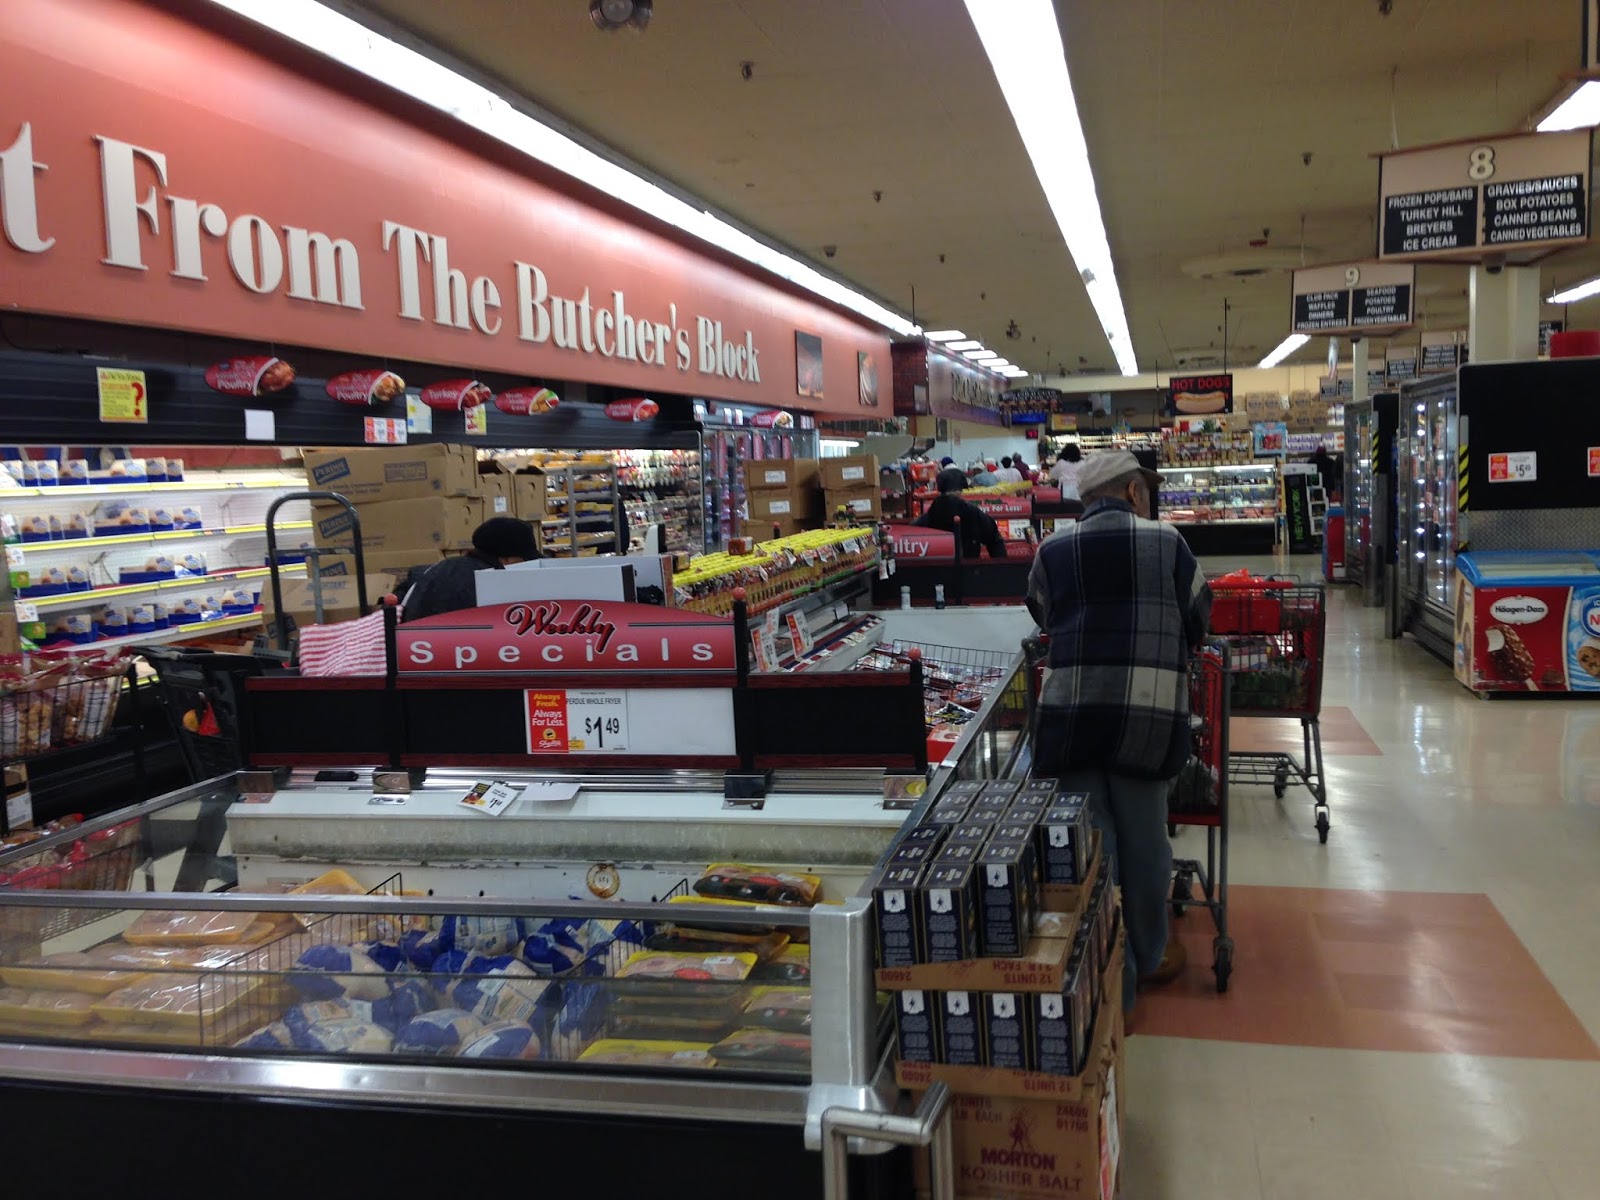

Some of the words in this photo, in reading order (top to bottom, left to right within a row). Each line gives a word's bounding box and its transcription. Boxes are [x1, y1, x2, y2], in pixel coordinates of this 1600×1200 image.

[1468, 146, 1495, 181] 8
[1487, 175, 1578, 198] GRAVIES/SAUCES
[1388, 194, 1422, 209] FROZEN
[1424, 188, 1474, 205] POPS/BARS
[1496, 198, 1517, 212] BOX
[1520, 191, 1574, 209] POTATOES
[1400, 207, 1440, 222] TURKEY
[1441, 204, 1464, 217] HILL
[1494, 211, 1538, 227] CANNED
[1540, 207, 1577, 223] BEANS
[1406, 220, 1453, 236] BREYERS
[1490, 228, 1525, 243] CANNED
[1526, 222, 1581, 239] VEGETABLES
[1403, 237, 1419, 251] ICE
[1421, 235, 1457, 250] CREAM
[92, 134, 365, 310] From
[382, 220, 502, 336] The
[514, 260, 692, 370] Butcher's
[696, 315, 761, 383] Block
[1345, 266, 1360, 288] 9
[1366, 287, 1397, 297] SEAFOOD
[1308, 301, 1335, 311] WAFFLES
[1365, 295, 1396, 306] POTATOES
[1367, 305, 1394, 315] POULTRY
[1297, 321, 1319, 330] FROZEN
[1320, 319, 1347, 329] ENTREES
[1354, 316, 1374, 325] FROZEN
[1171, 378, 1195, 391] HOT
[1197, 376, 1230, 389] DOGS
[1495, 605, 1545, 615] Häagen-Dazs
[504, 601, 617, 654] Weekly
[409, 639, 714, 669] Specials
[533, 693, 561, 701] Always
[586, 697, 604, 705] WHOLE
[604, 697, 621, 705] FRYER
[532, 718, 546, 726] For
[546, 718, 565, 726] Less.
[533, 709, 562, 719] Always
[1003, 972, 1037, 985] UNITS
[980, 1147, 1056, 1171] MORTON
[960, 1164, 1032, 1187] KOSHER
[1039, 1172, 1084, 1192] SALT
